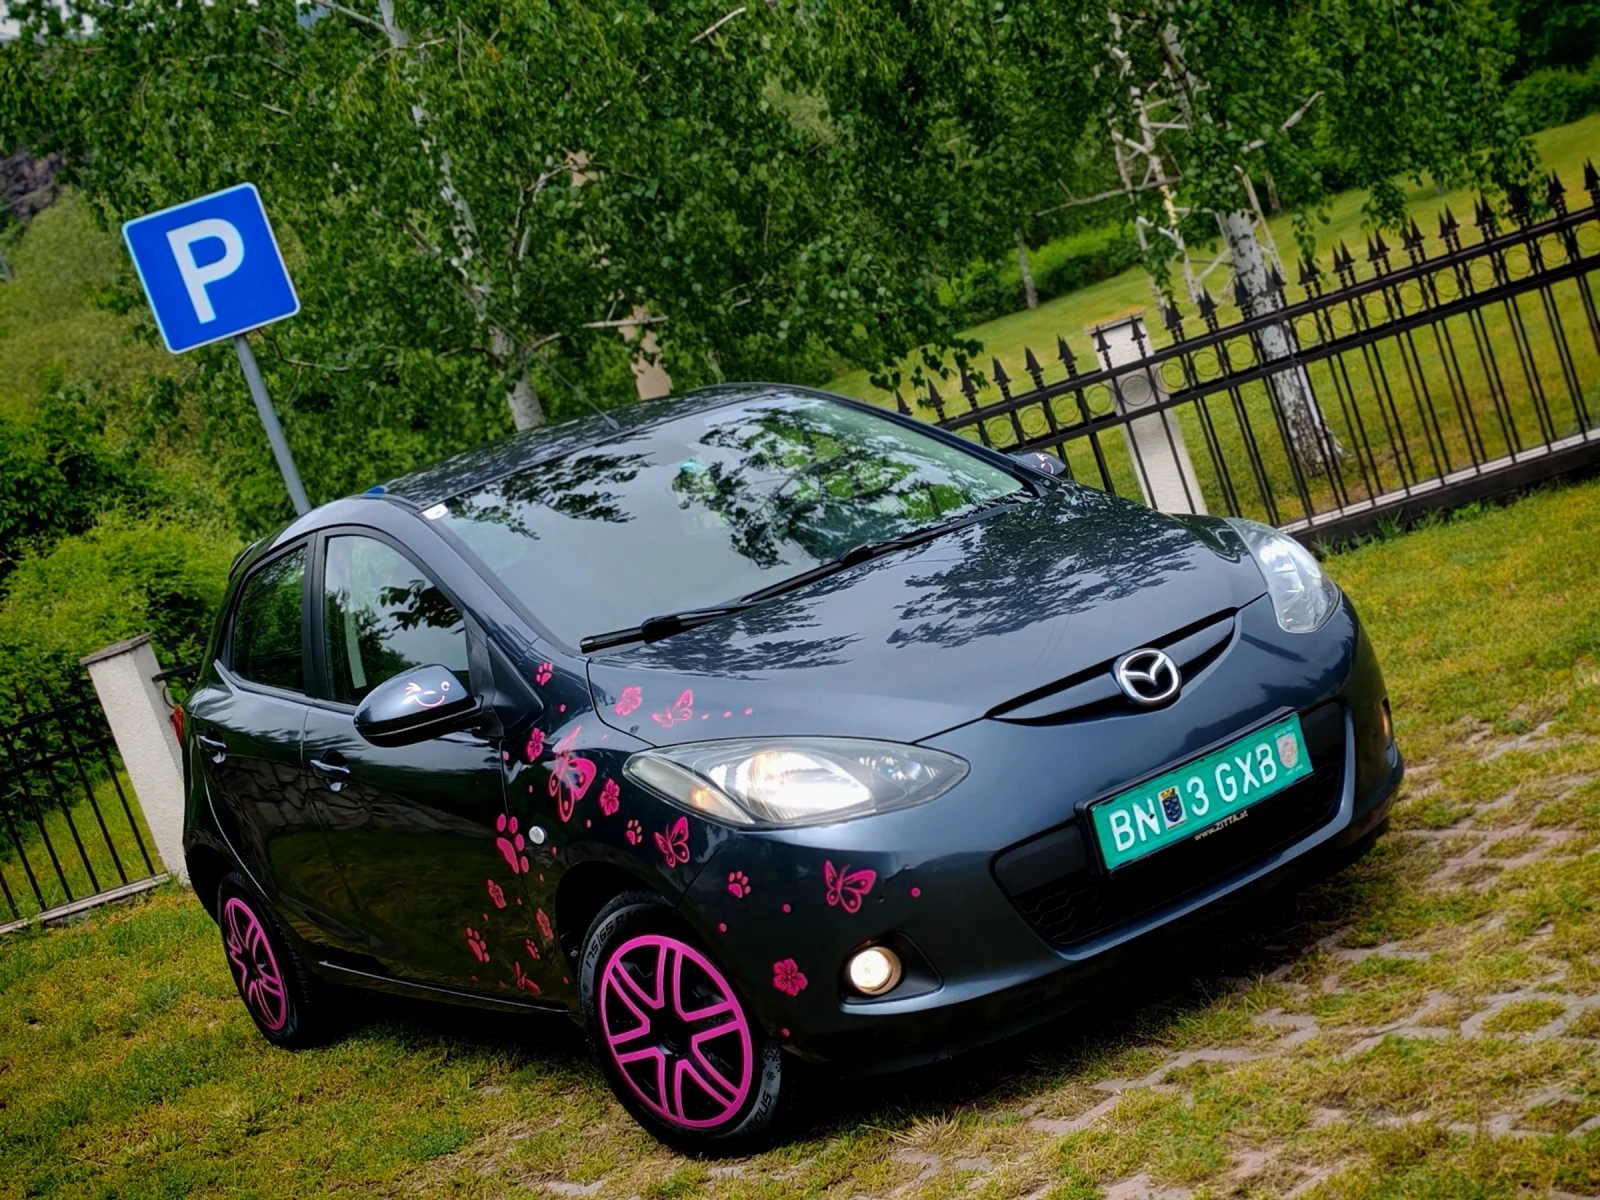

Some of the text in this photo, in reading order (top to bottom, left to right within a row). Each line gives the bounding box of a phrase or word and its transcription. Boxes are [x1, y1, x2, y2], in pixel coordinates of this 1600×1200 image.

[166, 218, 245, 325] P
[1109, 743, 1277, 852] BN 3 GXB
